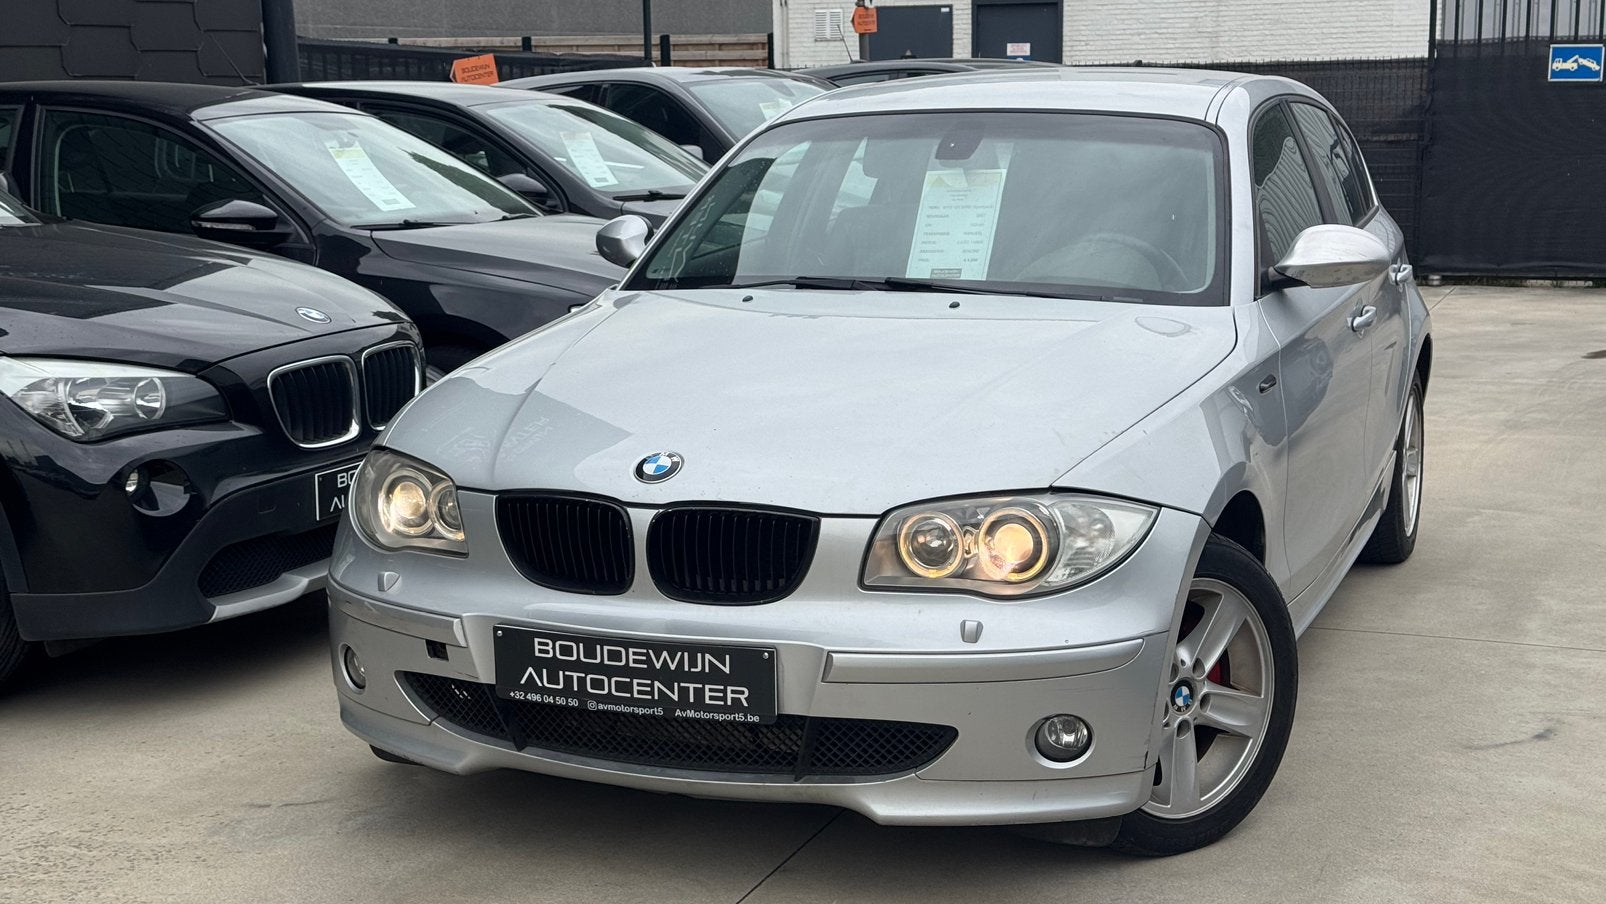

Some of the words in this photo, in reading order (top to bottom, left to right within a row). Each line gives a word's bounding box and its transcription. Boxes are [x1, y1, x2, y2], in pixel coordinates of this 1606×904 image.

[534, 637, 730, 674] BOUDEWIJN
[509, 690, 525, 700] +32
[526, 692, 541, 702] 496
[543, 694, 554, 704] 04
[555, 696, 566, 706] 50
[567, 698, 579, 707] 50
[520, 666, 749, 707] AUTOCENTER
[675, 708, 760, 722] AvMotorsport5.be
